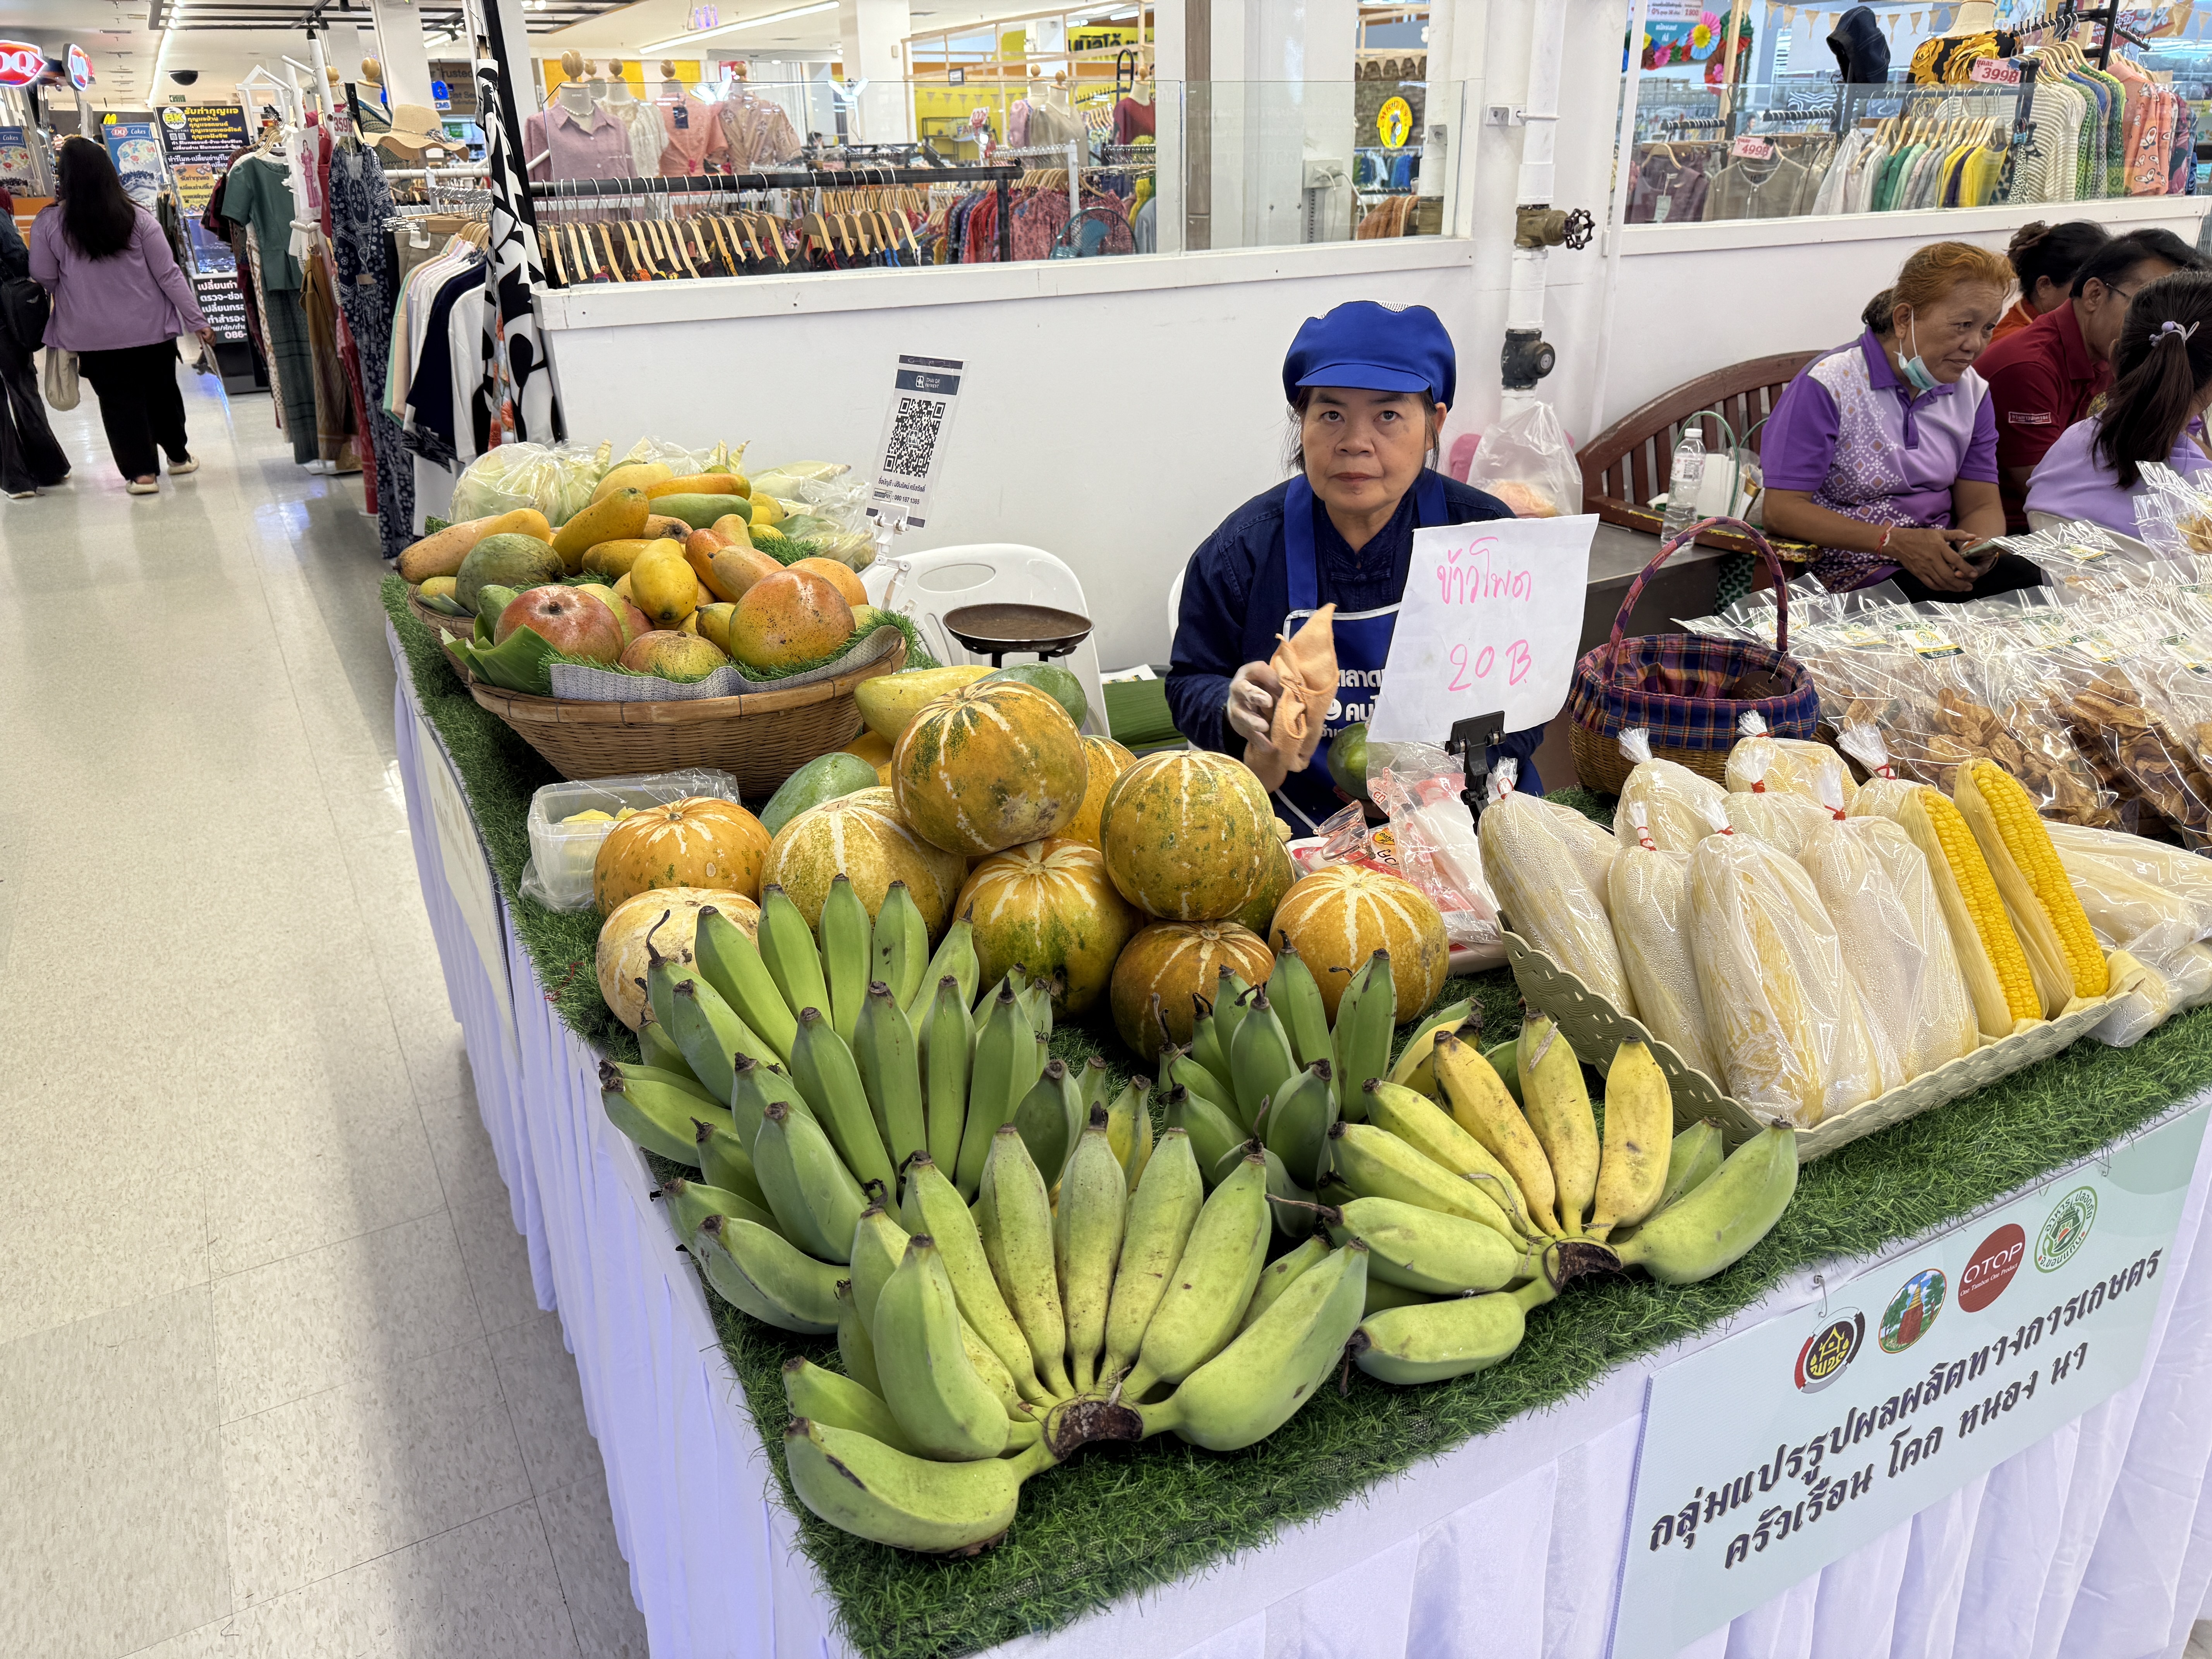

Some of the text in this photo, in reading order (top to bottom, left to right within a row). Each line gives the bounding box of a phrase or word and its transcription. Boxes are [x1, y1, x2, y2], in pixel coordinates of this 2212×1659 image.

[163, 113, 185, 122] BK
[184, 107, 239, 116] รับทำกุญแจ
[198, 279, 238, 290] เปลี่ยนถ่า
[1437, 536, 1531, 605] ข้าวโพด
[1338, 669, 1386, 687] ตลาด
[1448, 644, 1494, 692] 20
[1960, 1288, 1970, 1297] One
[1990, 1273, 2000, 1281] One
[2001, 1262, 2018, 1277] Product
[1964, 1242, 2023, 1283] OTOP
[1649, 1247, 2163, 1551] กลุ่มแปรรูปผลผลิตทางการเกษตร
[1724, 1342, 2088, 1569] ครัวเรือน โคก หนอง นา
